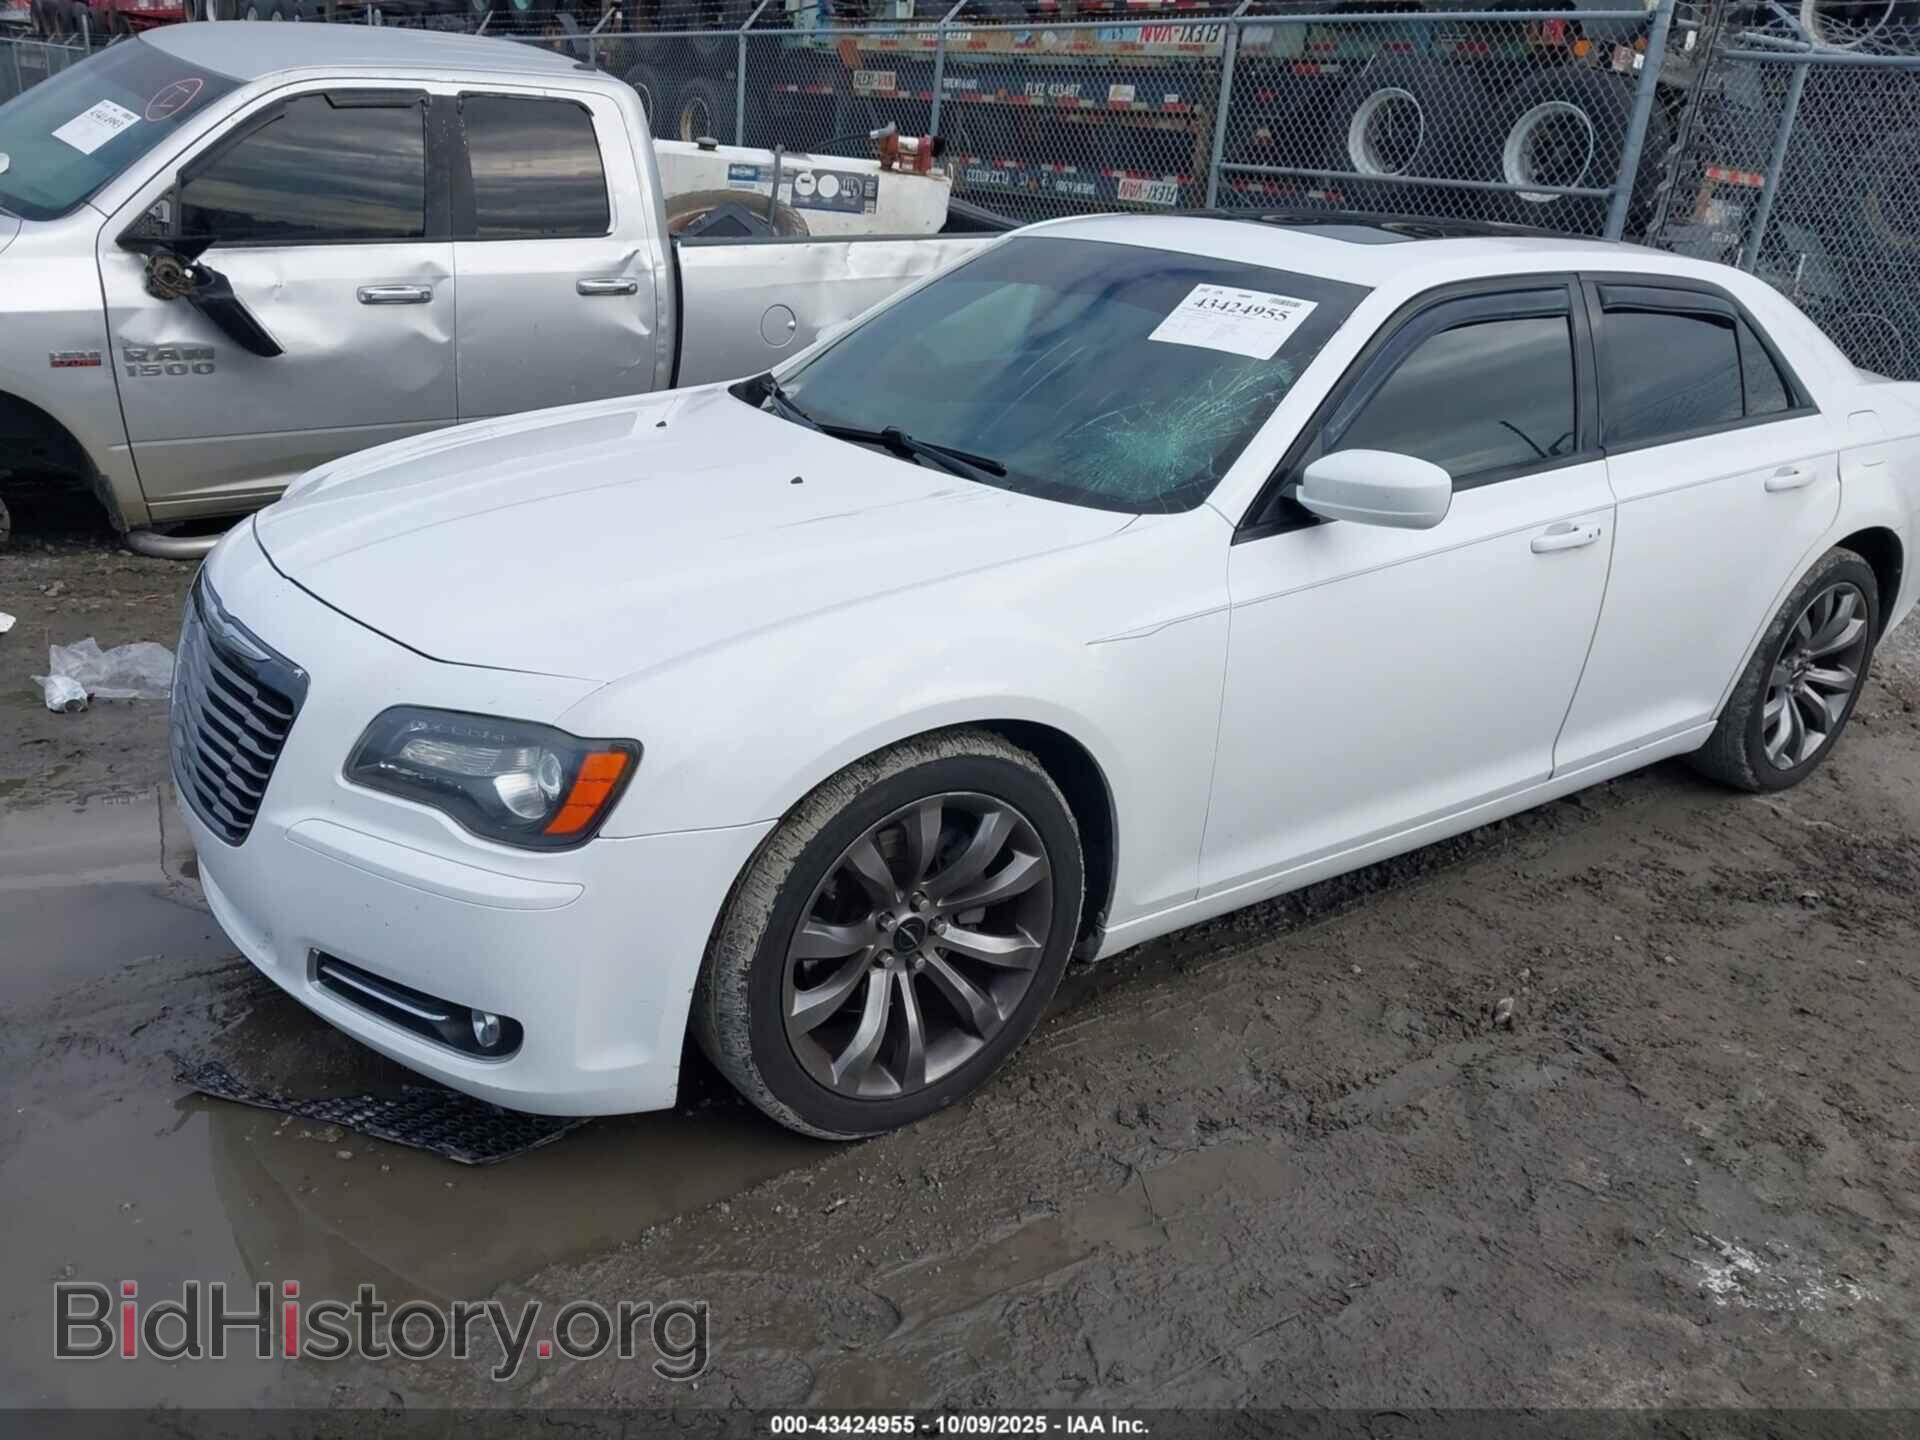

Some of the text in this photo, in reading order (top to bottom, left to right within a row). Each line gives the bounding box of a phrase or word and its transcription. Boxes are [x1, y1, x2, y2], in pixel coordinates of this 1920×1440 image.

[1139, 24, 1222, 44] FLEXI-VAN
[1193, 296, 1291, 322] 43424955
[122, 346, 216, 362] RAM
[125, 363, 216, 377] 1500
